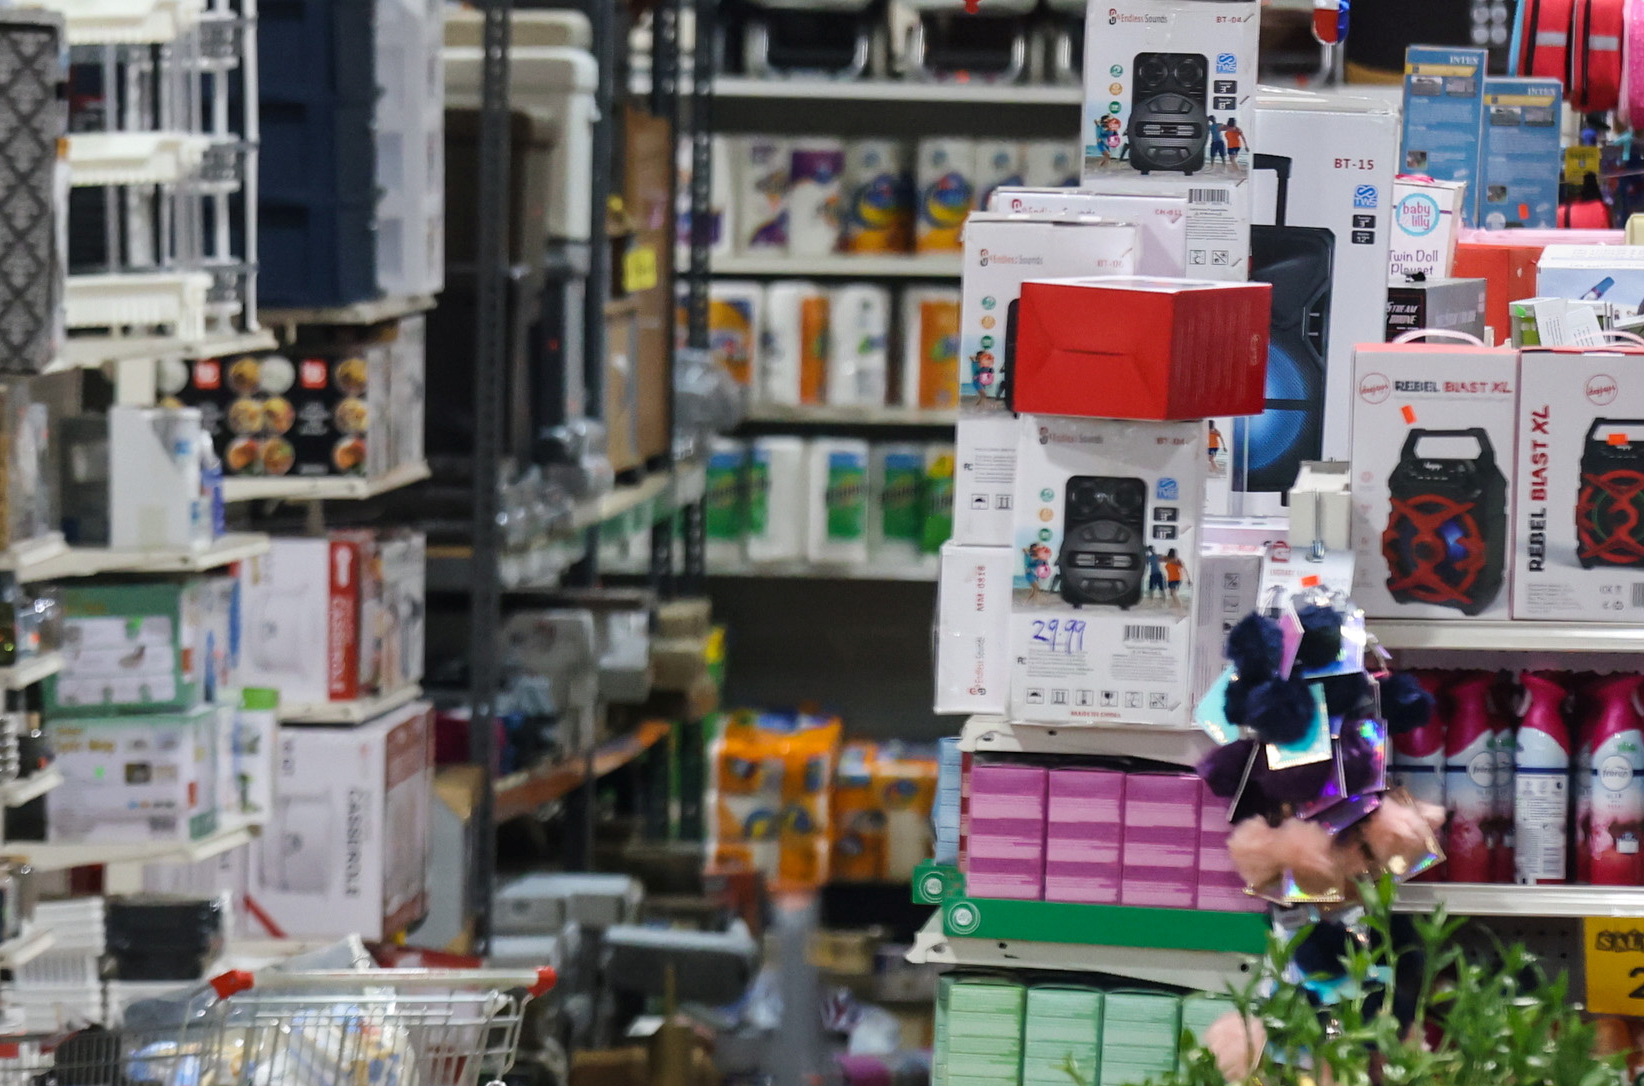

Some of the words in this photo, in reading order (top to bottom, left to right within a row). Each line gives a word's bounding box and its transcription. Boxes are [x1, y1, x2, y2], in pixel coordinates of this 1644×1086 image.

[1121, 14, 1144, 23] Endless
[1145, 14, 1168, 24] Sounds
[1334, 158, 1374, 170] BT-15
[1403, 202, 1430, 217] baby
[1412, 215, 1429, 230] lilly
[1389, 250, 1413, 262] Twin
[1416, 250, 1438, 262] Doll
[1395, 381, 1440, 393] REBEL
[1444, 382, 1487, 393] BLAST
[1492, 383, 1513, 393] XL
[1532, 406, 1550, 434] XL
[1532, 440, 1548, 501] BLAST
[1529, 508, 1546, 572] REBEL
[1032, 619, 1087, 655] 29.99
[1596, 930, 1644, 952] SAL
